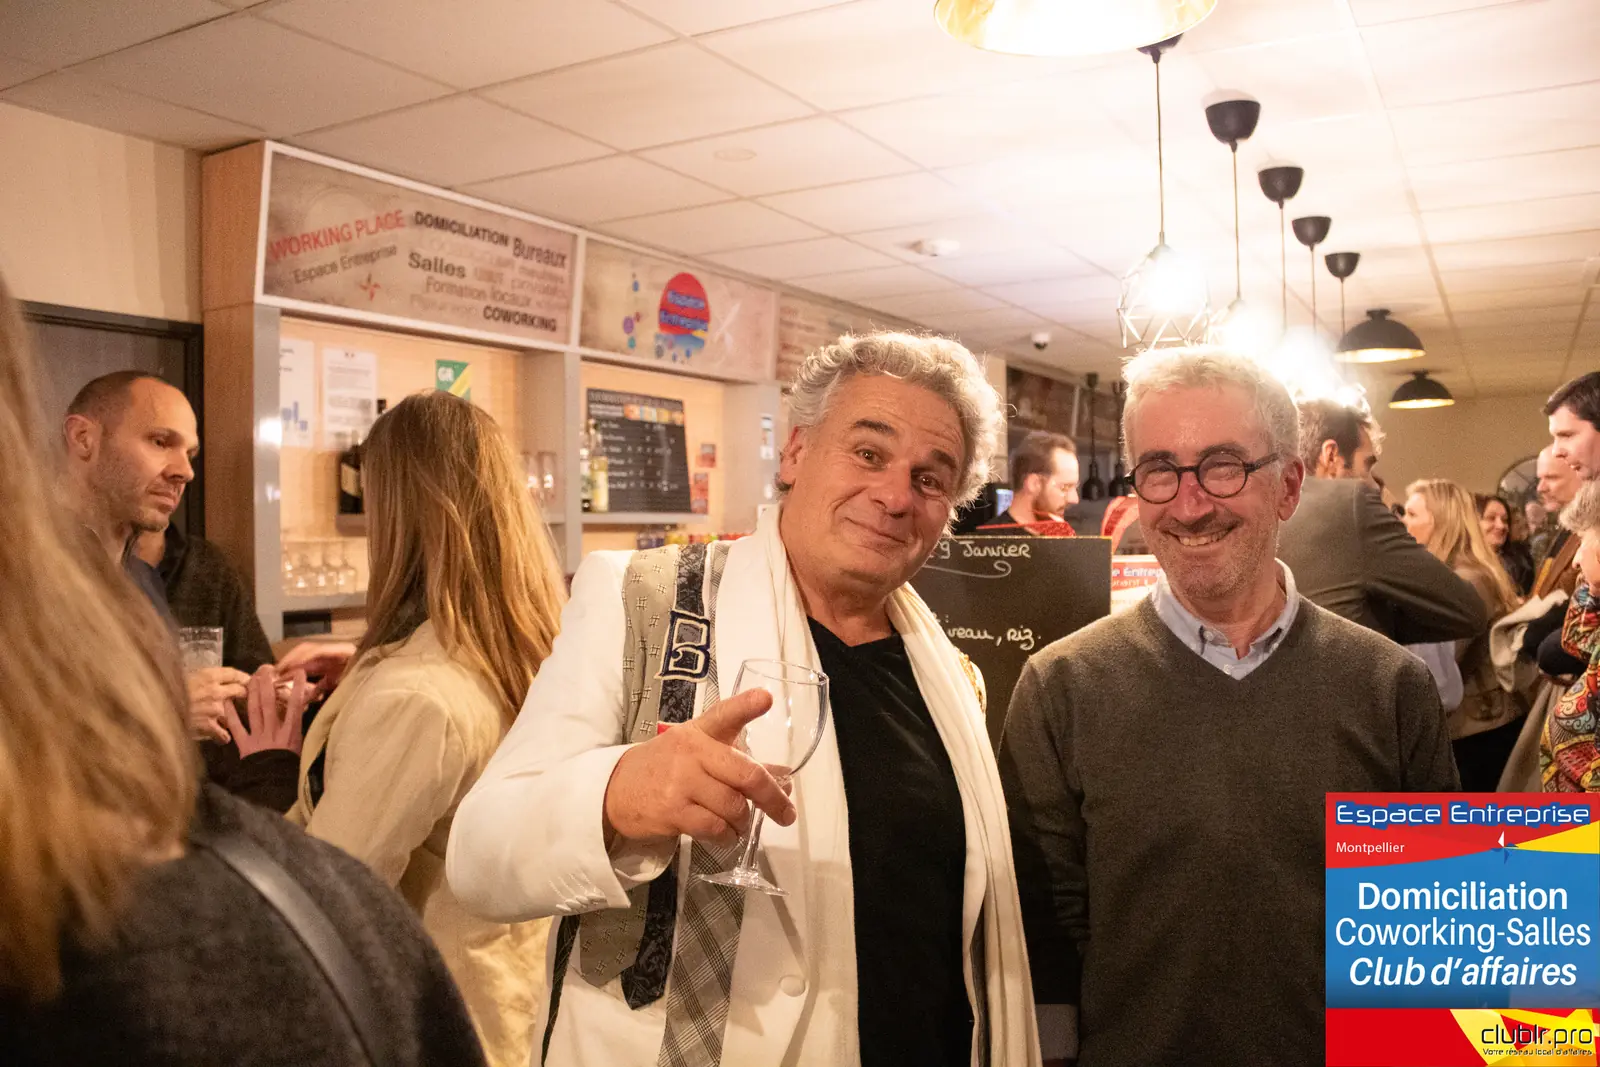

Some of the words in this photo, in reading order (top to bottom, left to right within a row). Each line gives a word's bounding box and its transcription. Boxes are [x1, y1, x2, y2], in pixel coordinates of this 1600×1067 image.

[268, 223, 353, 260] WORKING
[355, 209, 406, 238] PLACE
[414, 211, 510, 247] DOMICILIATION
[512, 237, 567, 268] Bureaux
[292, 261, 338, 284] Espace
[340, 245, 397, 270] Entreprise
[407, 252, 466, 278] Salles
[426, 276, 487, 300] Formation
[483, 305, 557, 332] COWORKING
